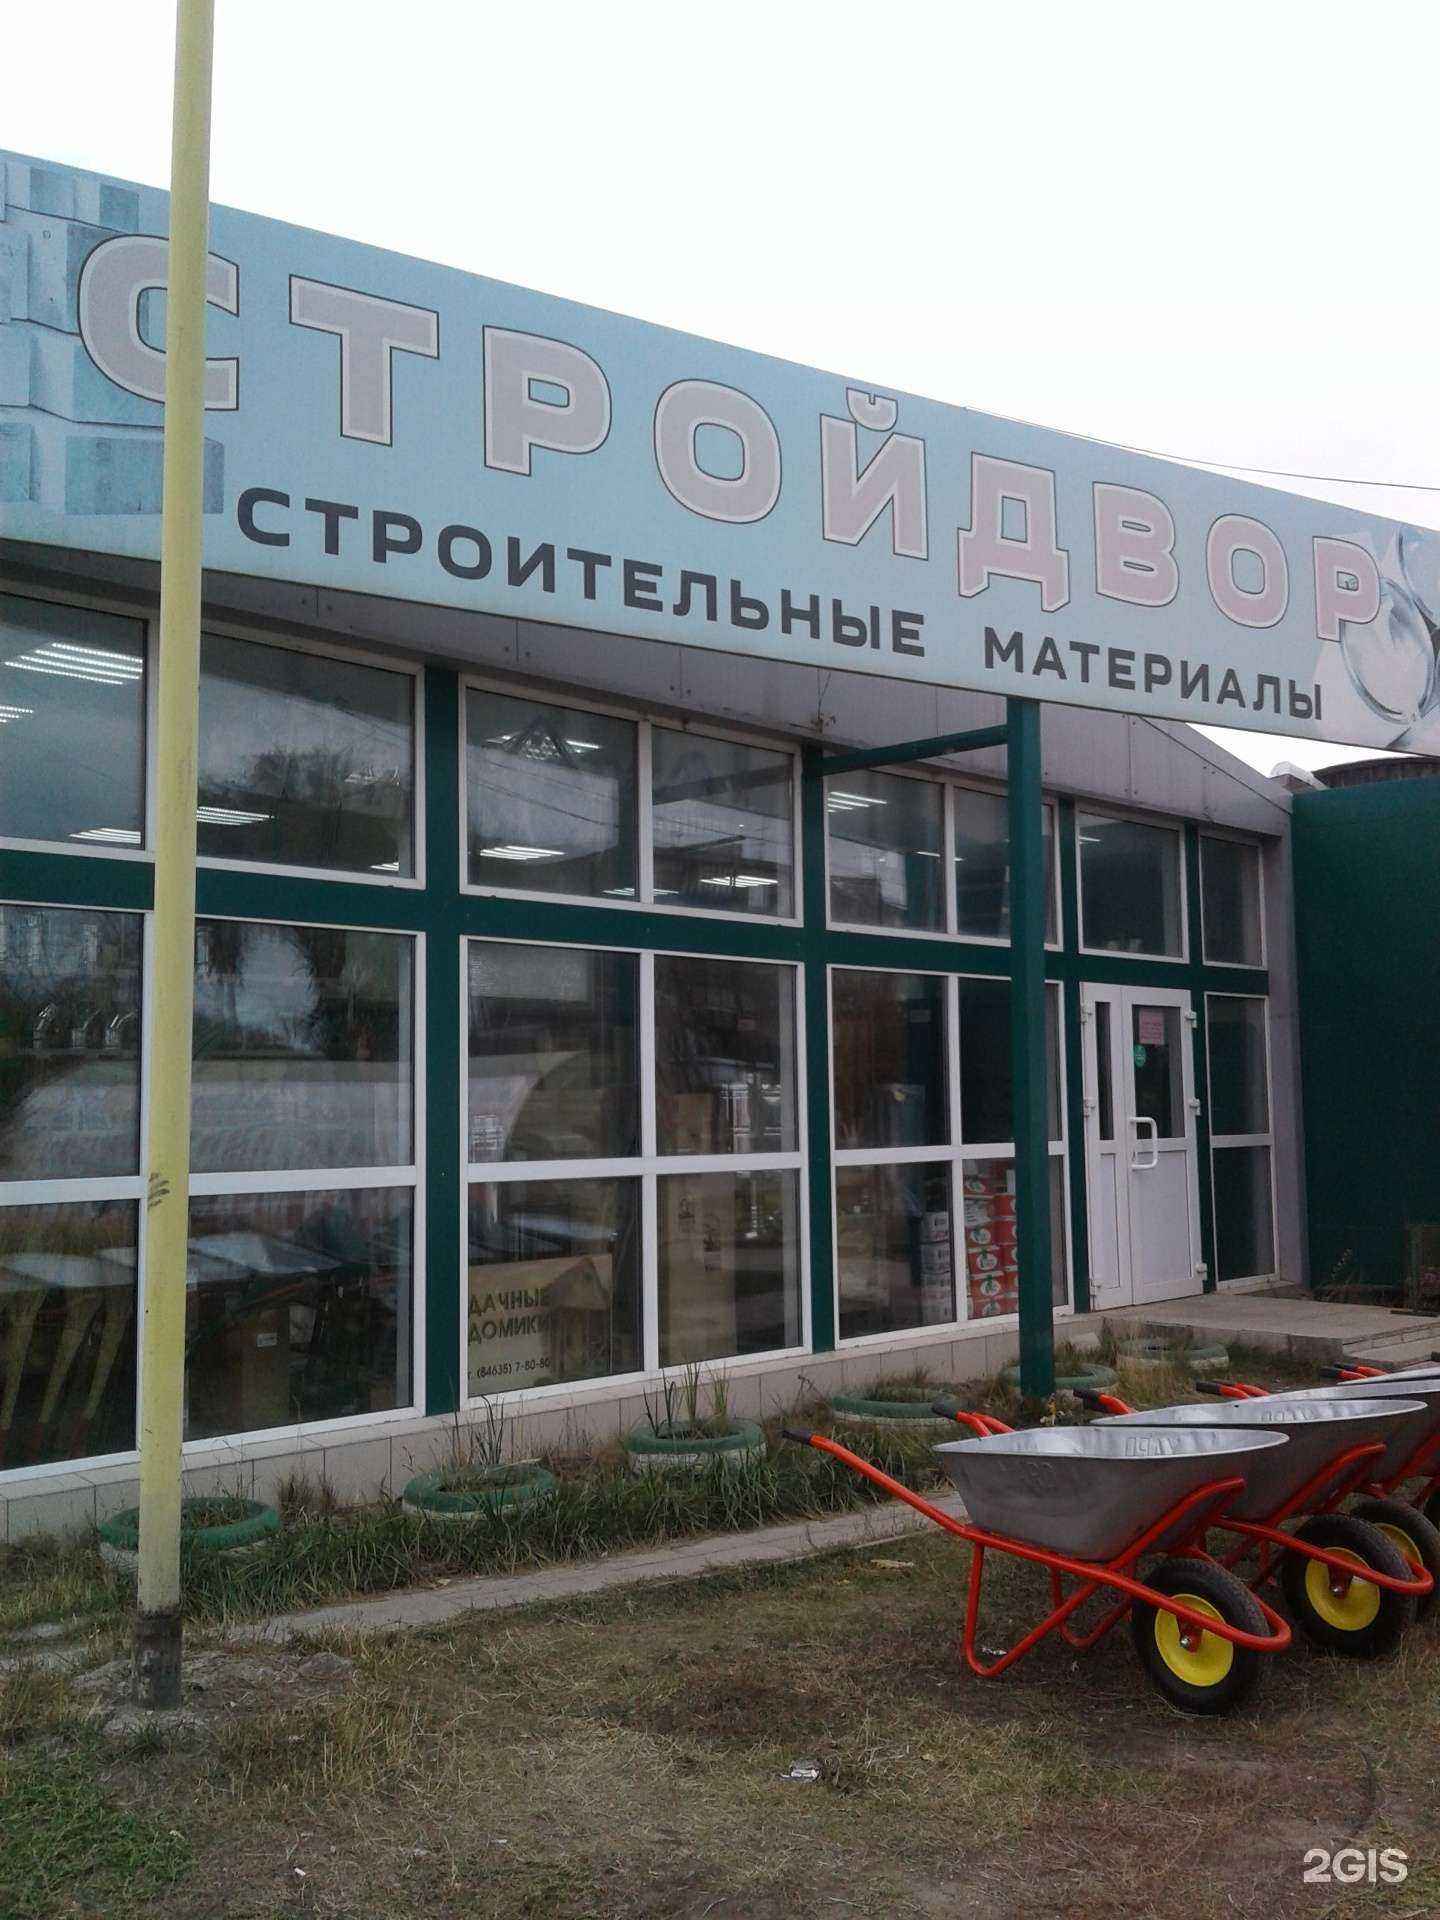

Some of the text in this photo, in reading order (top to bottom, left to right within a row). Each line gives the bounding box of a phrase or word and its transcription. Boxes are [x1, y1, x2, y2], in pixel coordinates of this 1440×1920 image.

[237, 487, 1322, 721] СТРОИТЕЛЬНЫЕ МАТЕРИАЛЫ
[469, 1287, 550, 1317] ДАЧНЫЕ
[468, 1313, 553, 1346] ДОМИКИ
